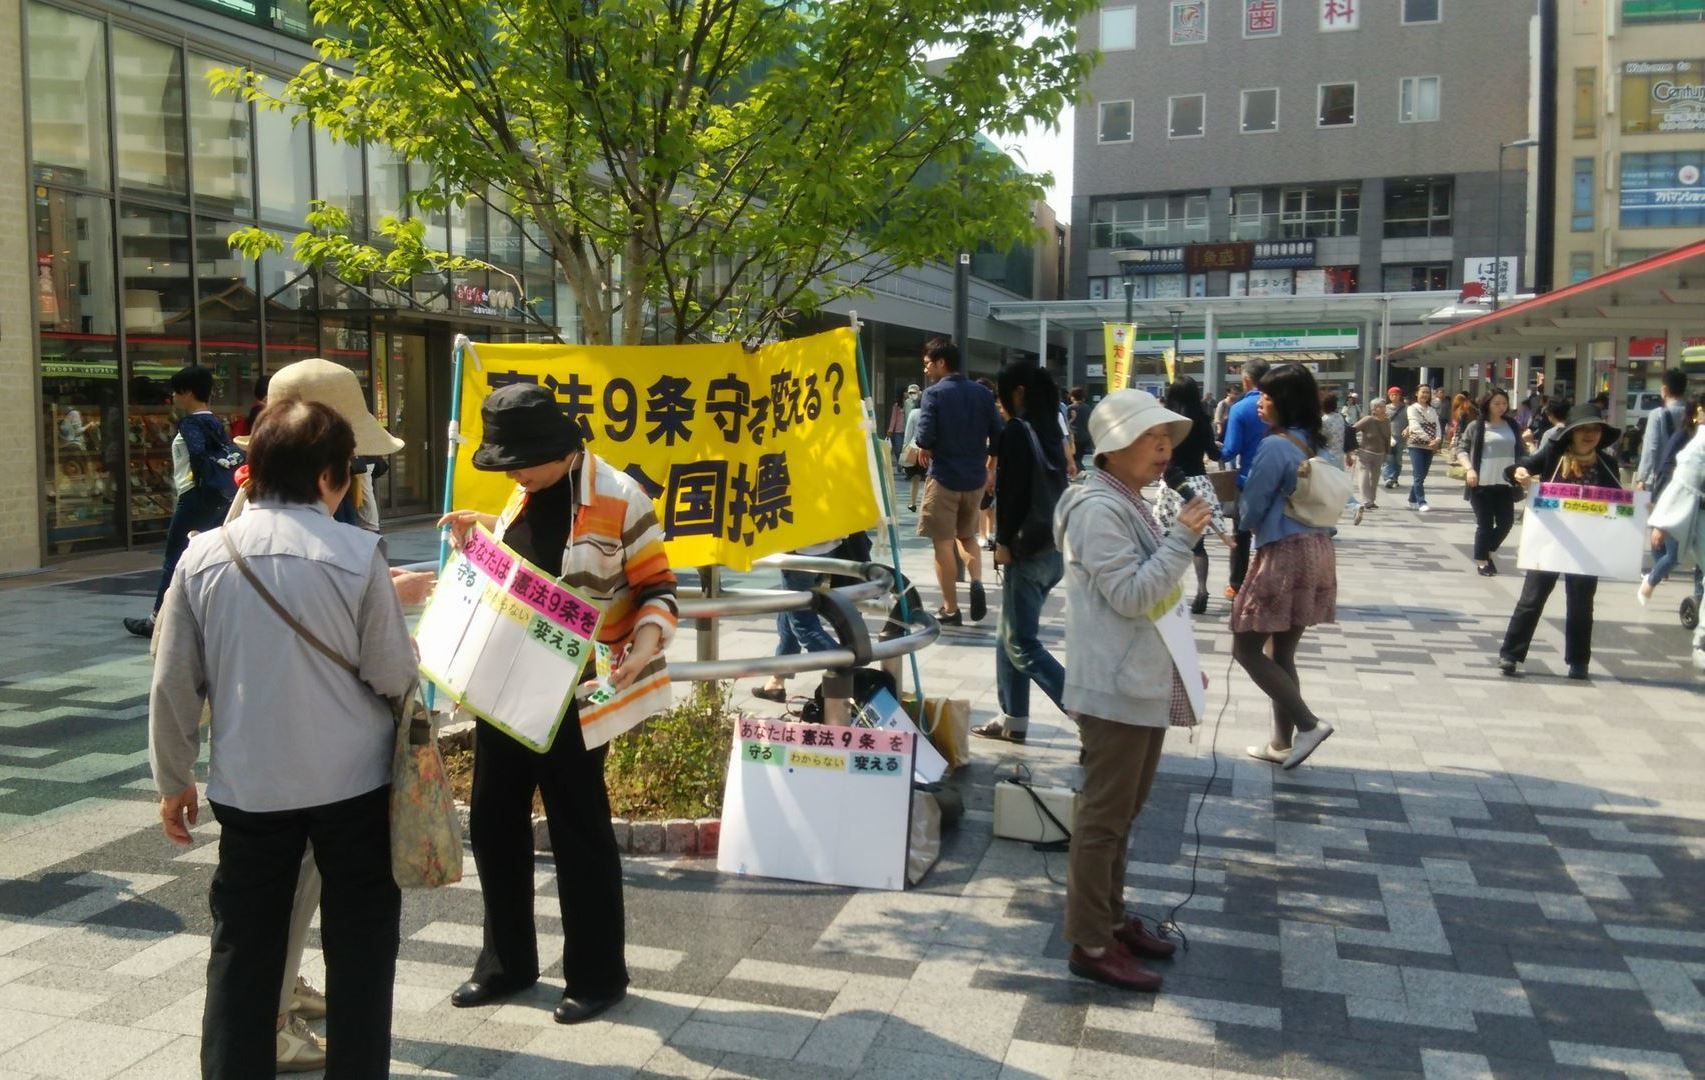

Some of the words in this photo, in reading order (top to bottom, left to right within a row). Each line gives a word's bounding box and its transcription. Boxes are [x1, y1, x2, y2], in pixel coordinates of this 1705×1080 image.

[1248, 1, 1276, 30] 歯
[1324, 0, 1354, 25] 科
[1249, 338, 1300, 348] FamilyMart
[1562, 501, 1608, 514] わからない
[464, 534, 511, 581] あなたは
[510, 568, 598, 635] 憲法9条を
[456, 560, 478, 588] 守る
[533, 617, 581, 658] 変える
[741, 723, 797, 743] あなたは
[749, 743, 773, 761] 守る
[790, 751, 846, 767] わからない
[854, 754, 899, 773] 変える
